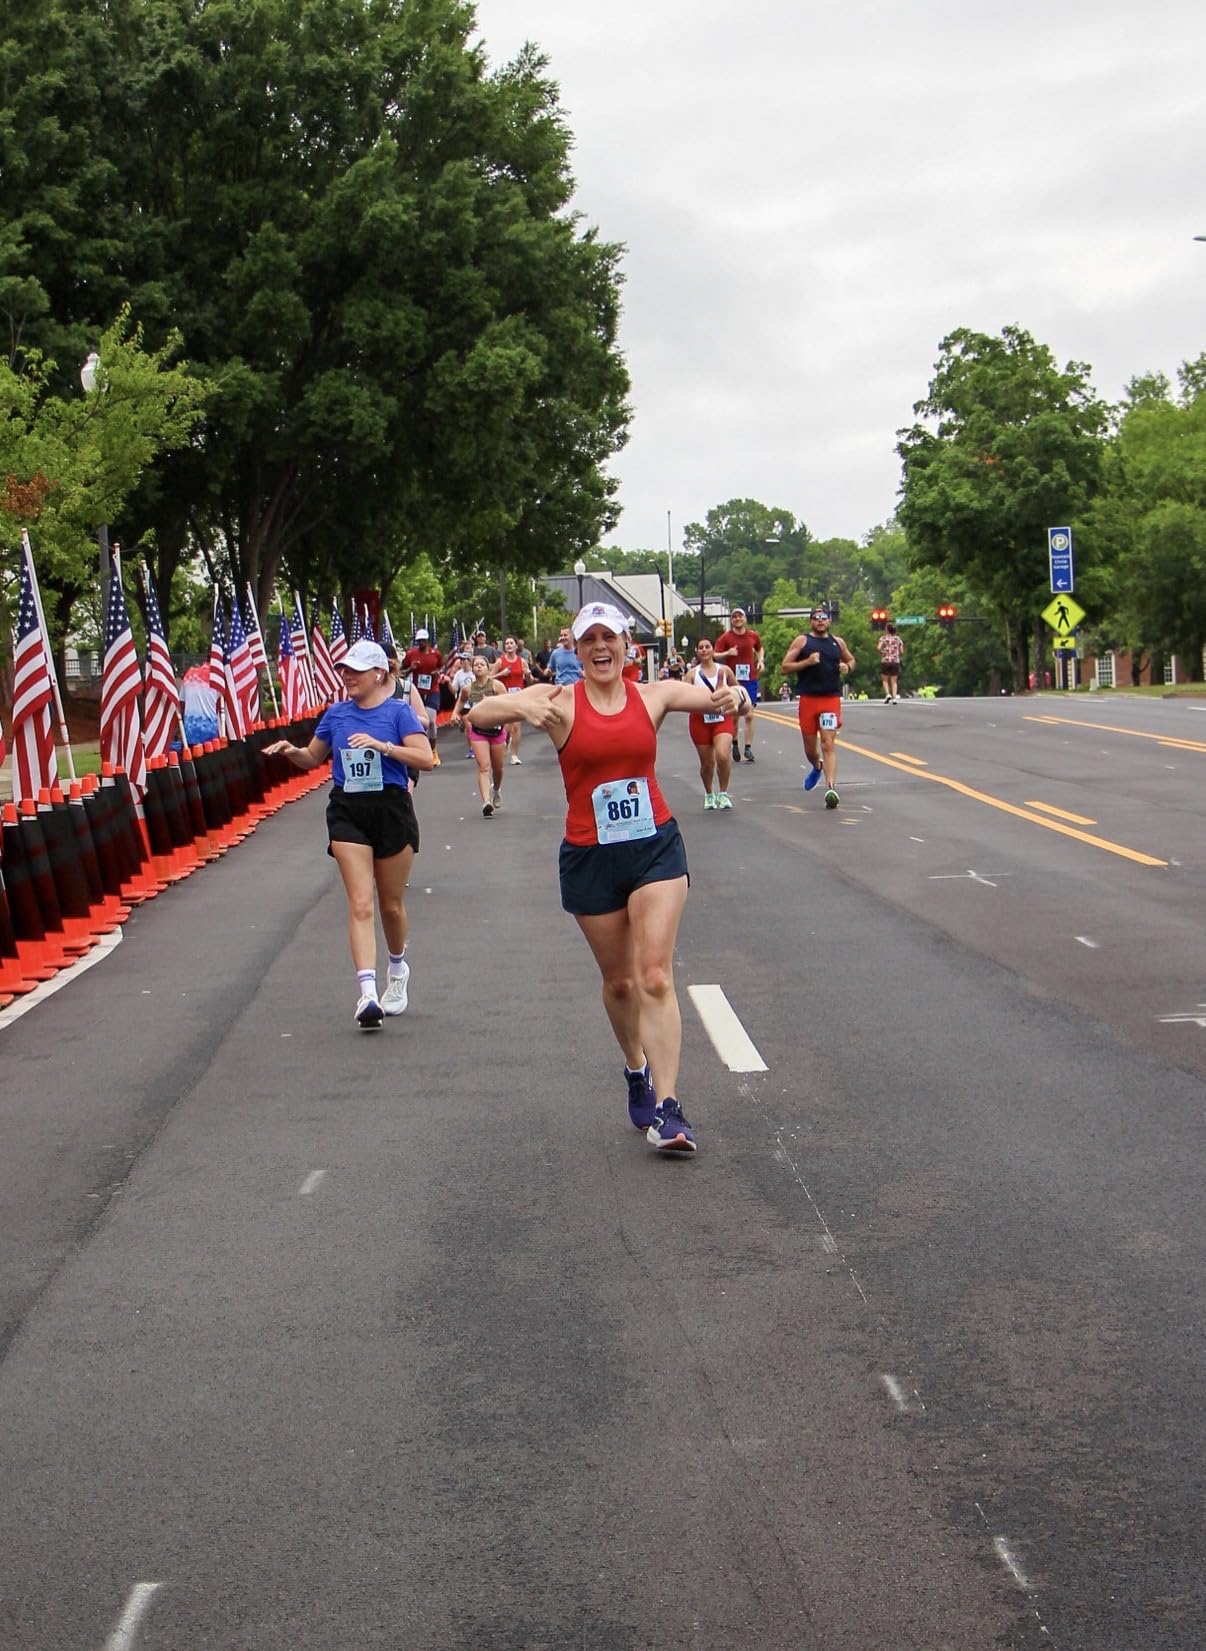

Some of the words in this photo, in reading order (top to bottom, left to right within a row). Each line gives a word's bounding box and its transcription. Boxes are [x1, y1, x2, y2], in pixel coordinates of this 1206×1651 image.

[1056, 537, 1065, 549] P
[349, 762, 371, 777] 197
[607, 798, 639, 821] 867
